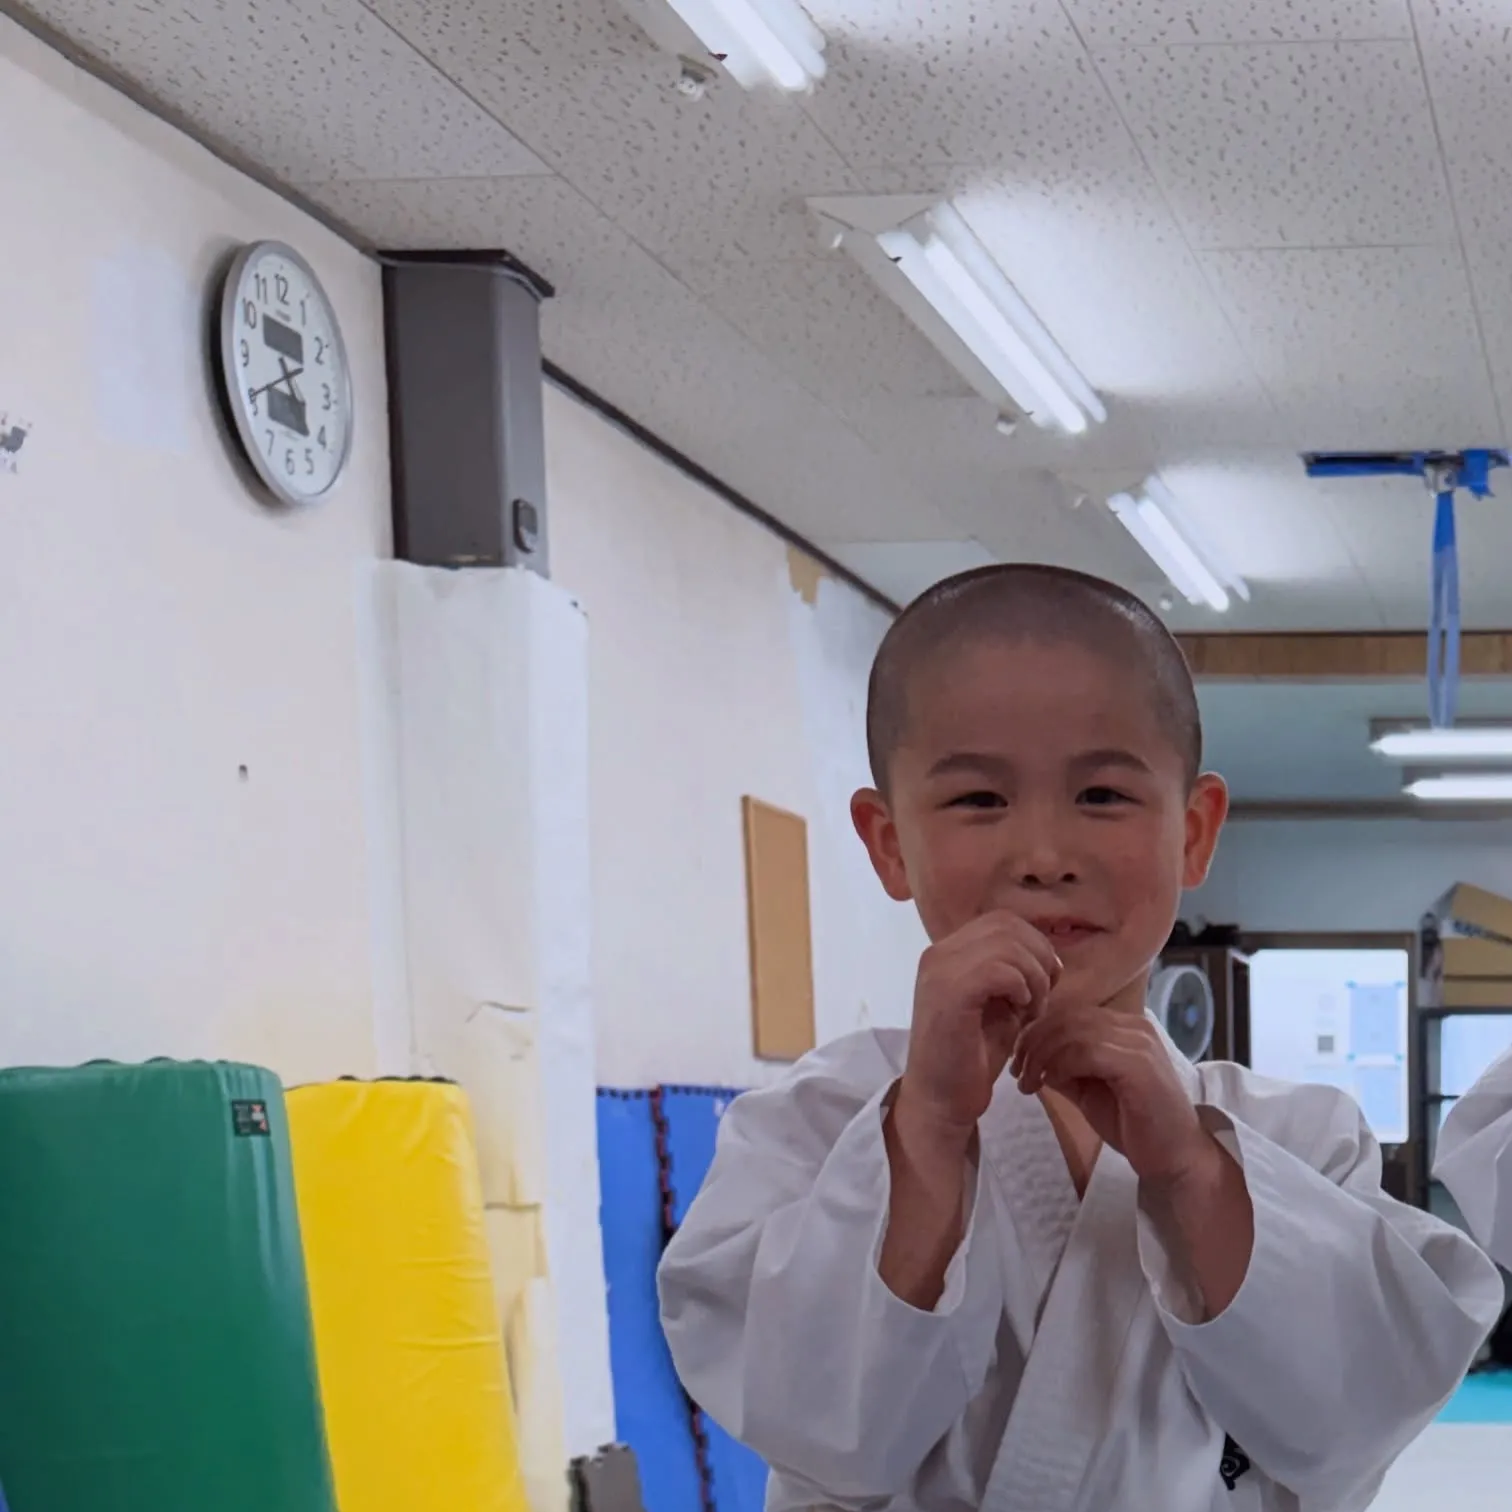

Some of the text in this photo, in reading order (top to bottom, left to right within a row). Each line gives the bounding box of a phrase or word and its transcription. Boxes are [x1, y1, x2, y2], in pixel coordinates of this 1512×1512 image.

[255, 273, 268, 304] 11
[274, 272, 289, 305] 12
[243, 297, 256, 330] 10
[240, 338, 249, 368] 9
[314, 336, 325, 366] 2
[321, 382, 332, 411] 3
[265, 429, 275, 456] 7
[317, 425, 327, 450] 4
[285, 448, 295, 476] 6
[304, 447, 314, 476] 5
